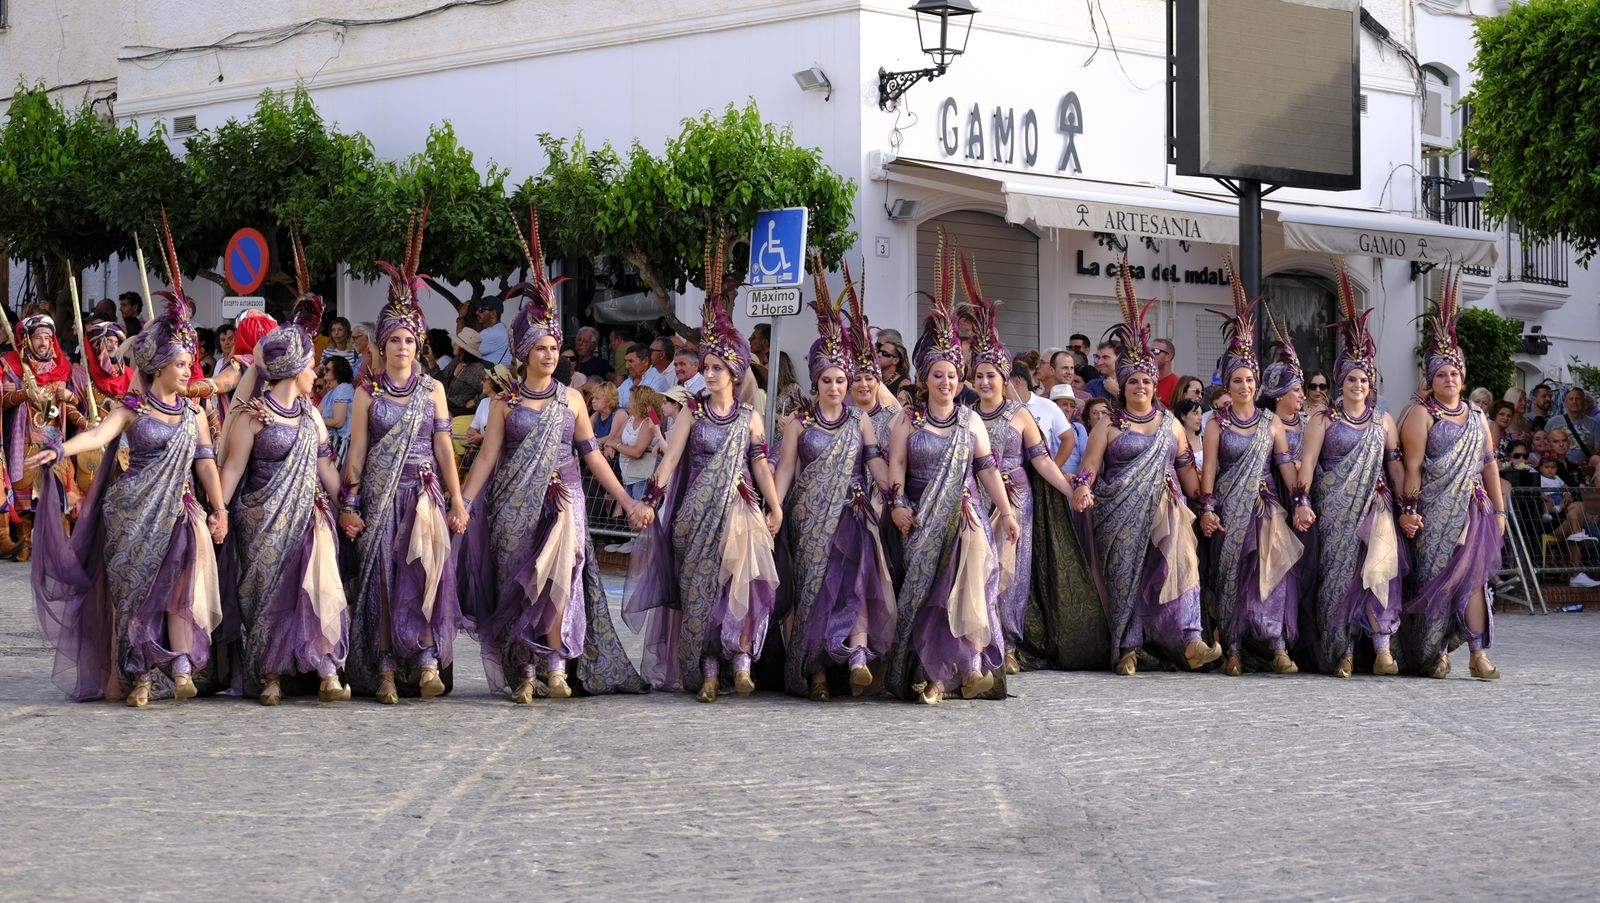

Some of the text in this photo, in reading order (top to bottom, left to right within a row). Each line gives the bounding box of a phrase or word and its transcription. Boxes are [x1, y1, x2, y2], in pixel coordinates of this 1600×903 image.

[942, 96, 1038, 167] GAMO
[1104, 210, 1202, 238] ARTESANIA
[880, 244, 885, 254] 3
[1359, 233, 1406, 257] GAMO
[1077, 250, 1100, 276] La
[1106, 263, 1145, 280] csa
[752, 291, 795, 302] Máximo
[752, 304, 794, 315] 2 Horas
